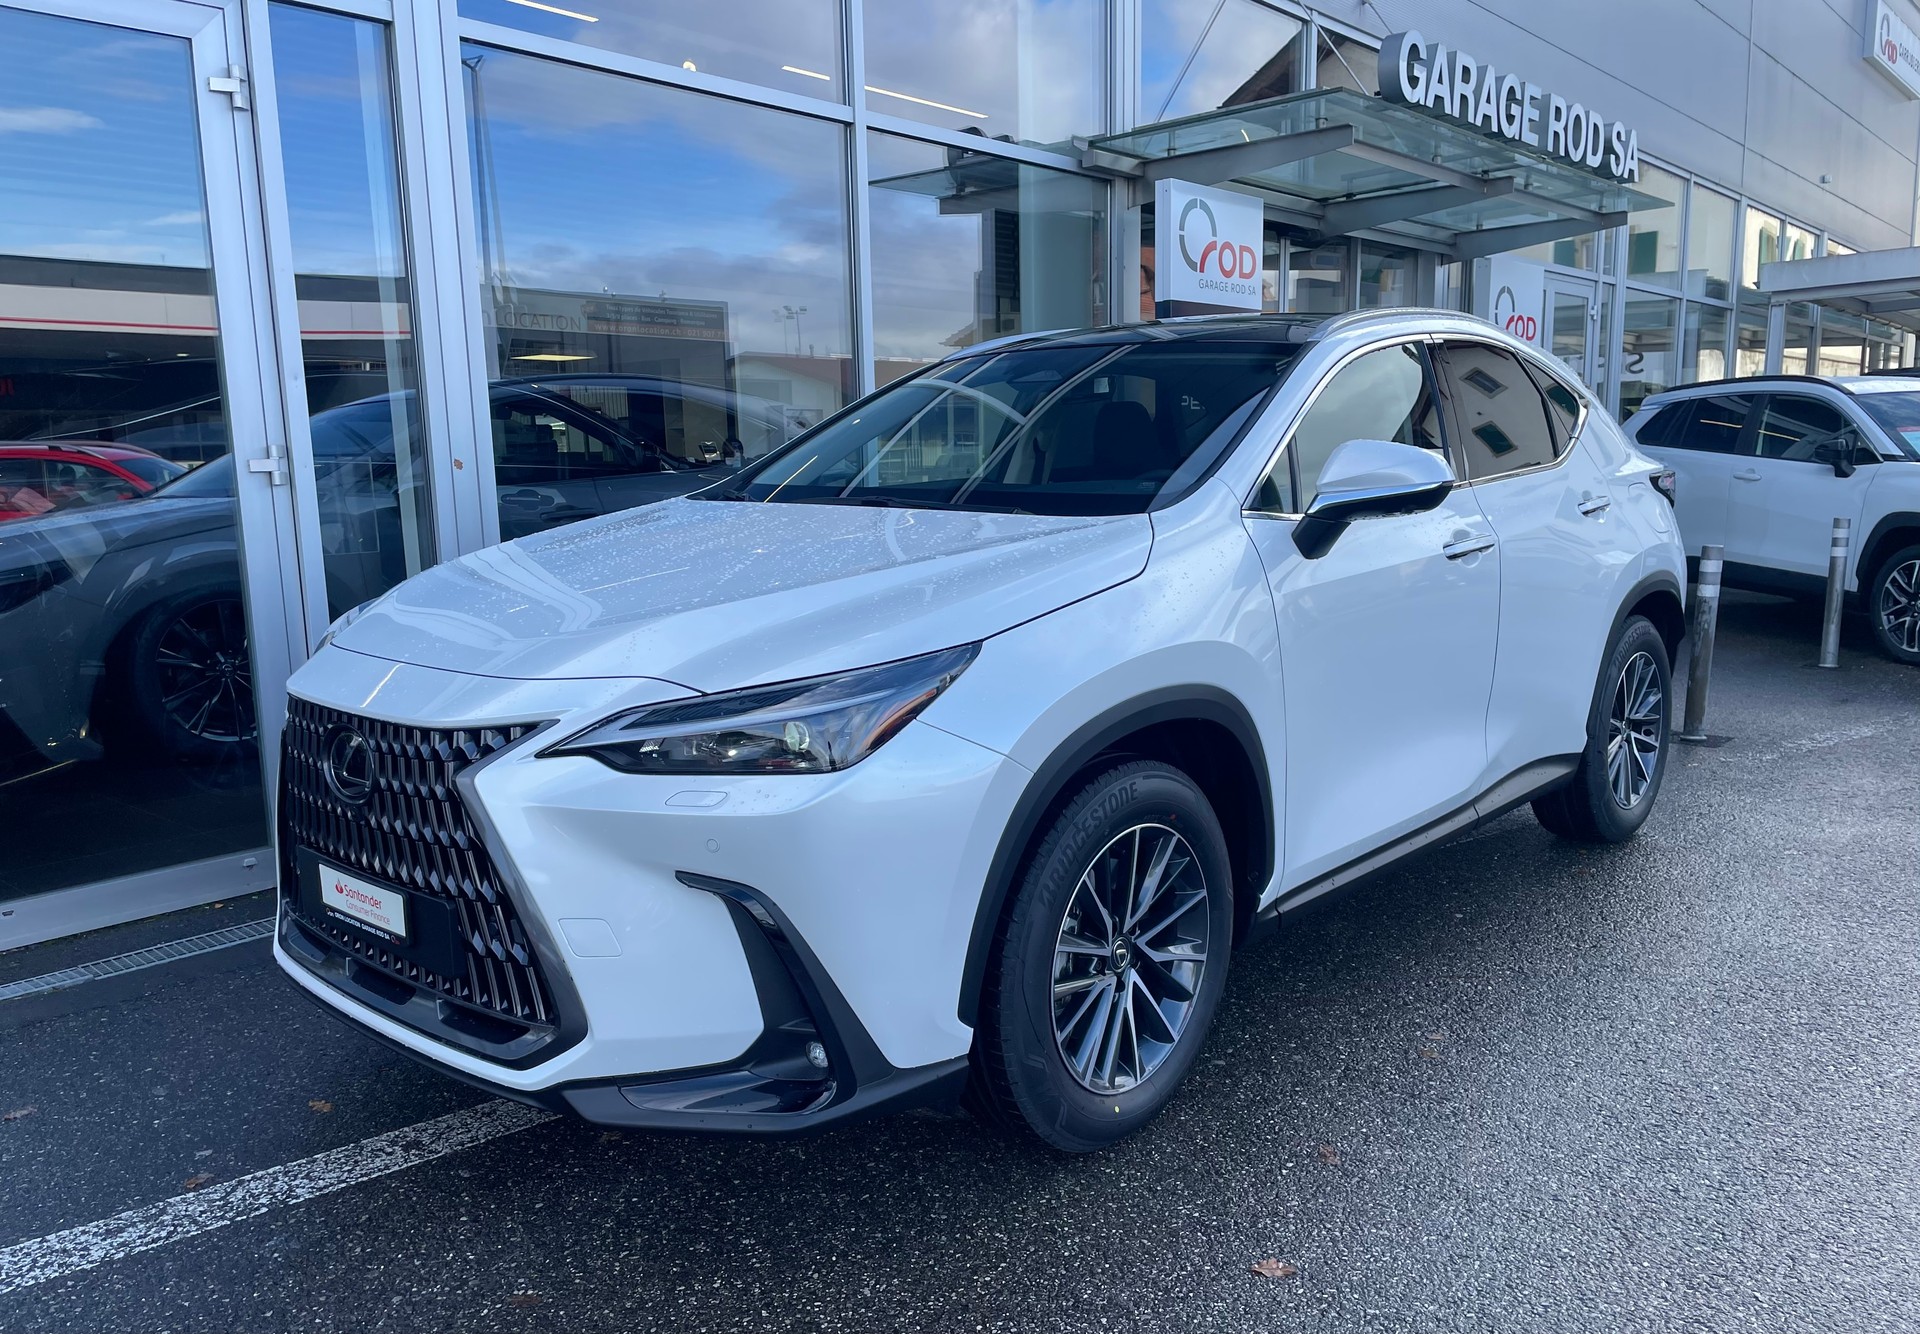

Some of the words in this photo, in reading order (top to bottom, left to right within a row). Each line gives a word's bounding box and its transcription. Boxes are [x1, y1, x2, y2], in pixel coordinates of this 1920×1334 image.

[1399, 29, 1542, 147] GARAGE
[1547, 93, 1605, 168] ROD
[1610, 120, 1639, 183] SA
[1198, 278, 1229, 293] GARAGE
[1231, 282, 1246, 295] ROD
[1247, 284, 1257, 296] SA
[495, 311, 582, 331] LOCATION
[687, 328, 700, 337] 021
[1041, 780, 1139, 908] BRIDGESTONE
[343, 883, 383, 910] Santander
[345, 899, 371, 916] Consumer
[370, 909, 391, 926] Finance
